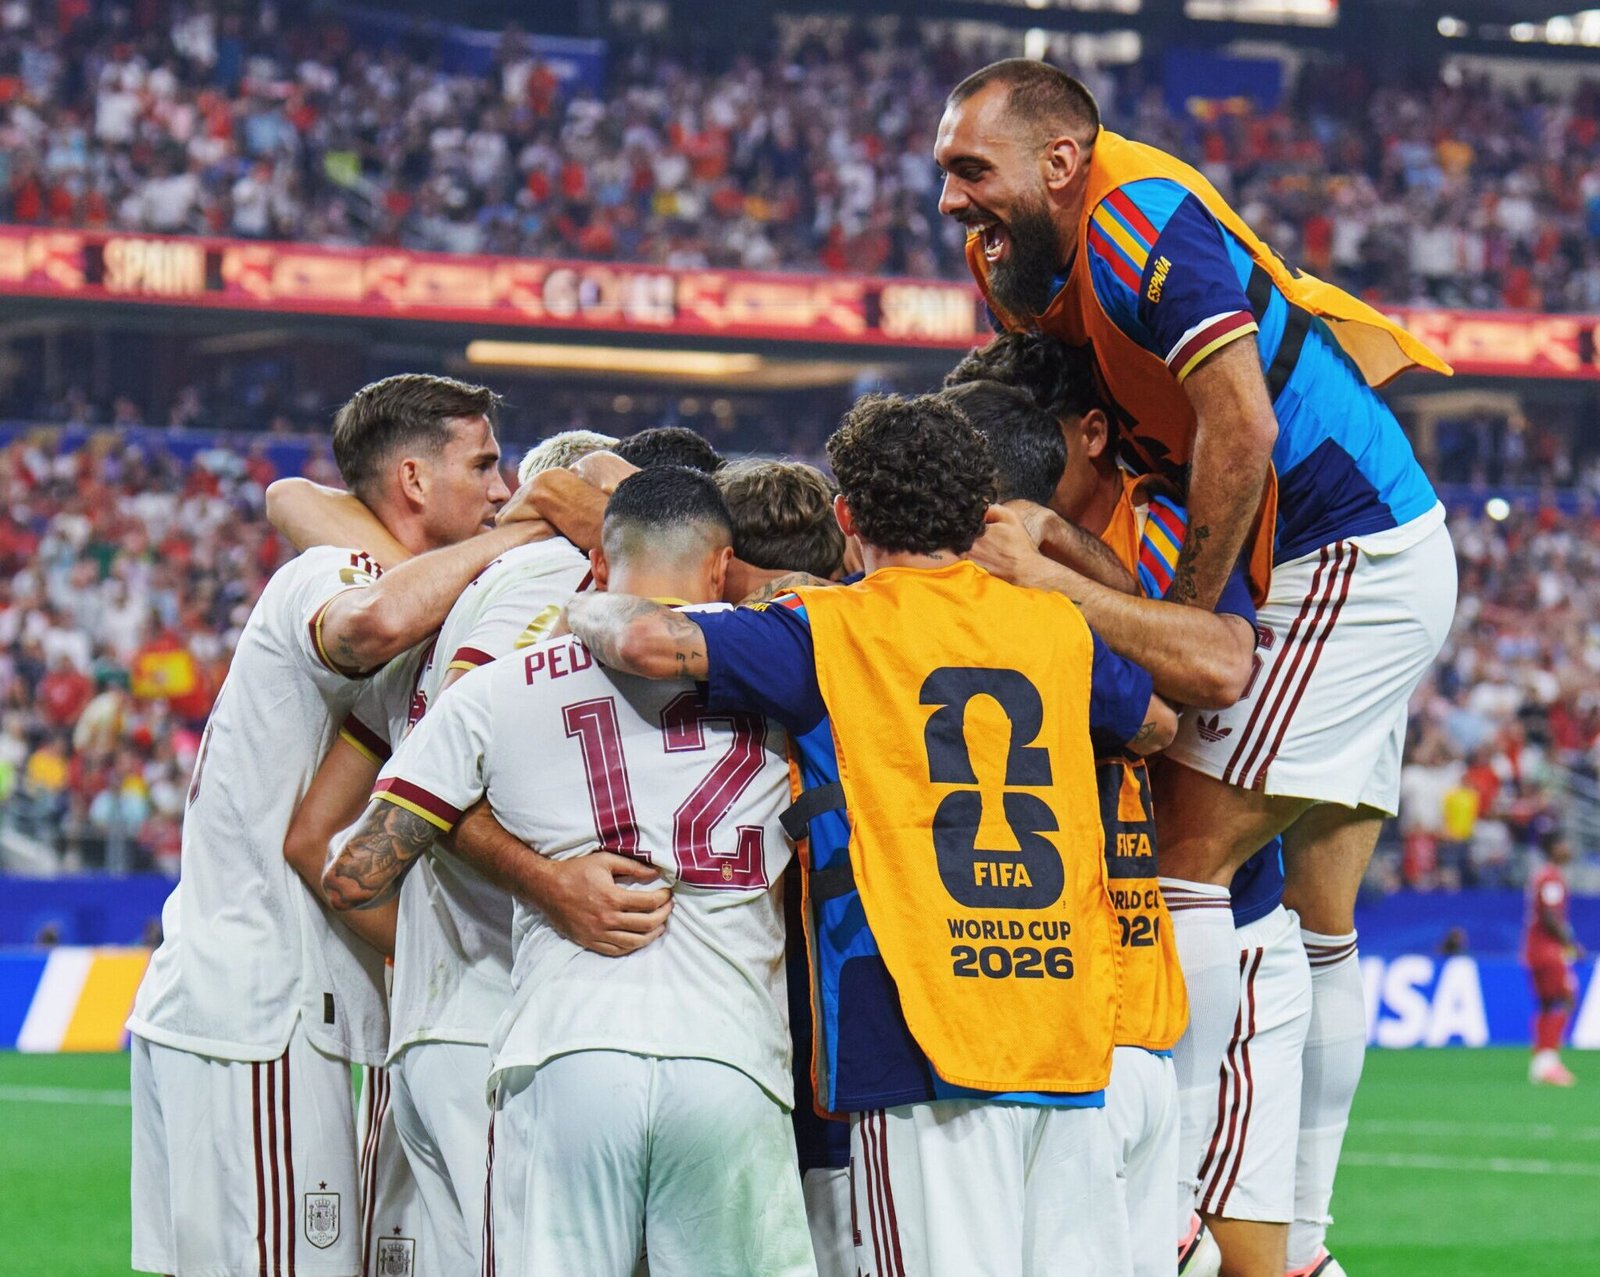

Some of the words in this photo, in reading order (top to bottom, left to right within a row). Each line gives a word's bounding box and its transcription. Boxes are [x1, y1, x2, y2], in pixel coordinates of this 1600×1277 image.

[1146, 255, 1172, 304] ESPAÑA
[561, 690, 770, 891] 12
[1116, 833, 1152, 857] FIFA
[973, 861, 1033, 888] FIFA
[947, 918, 1025, 940] WORLD
[1028, 920, 1071, 941] CUP
[950, 945, 1074, 980] 2026
[1358, 954, 1490, 1048] ISA
